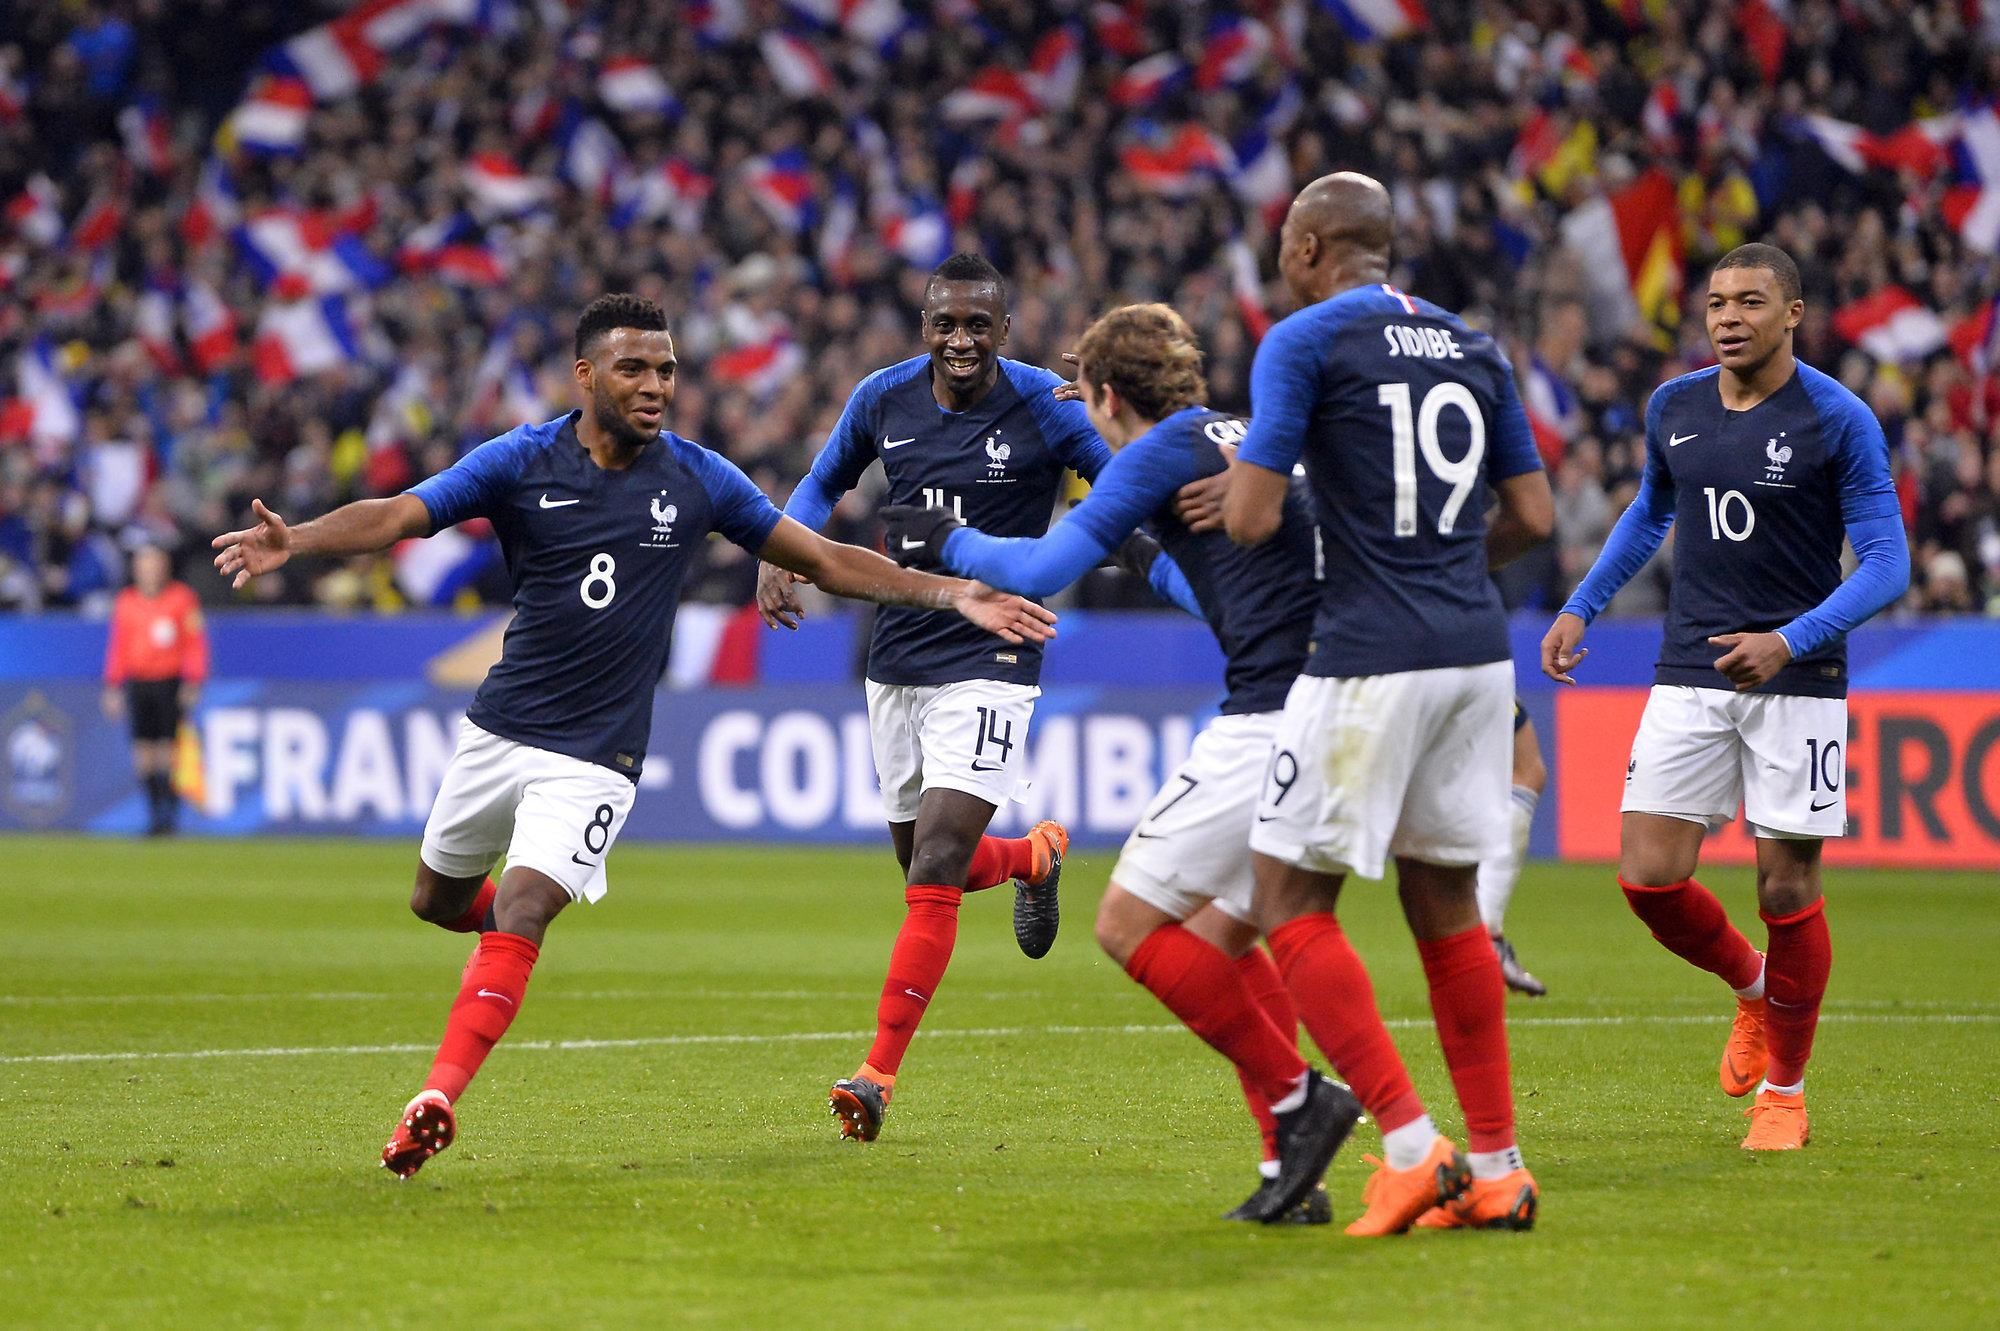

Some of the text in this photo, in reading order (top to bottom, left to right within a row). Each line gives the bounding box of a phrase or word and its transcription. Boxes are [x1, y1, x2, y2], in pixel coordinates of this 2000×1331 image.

[1384, 325, 1464, 359] SIDIBE
[1378, 382, 1485, 537] 19
[1703, 487, 1755, 542] 10
[580, 553, 616, 609] 8
[977, 706, 1013, 763] 14
[203, 708, 467, 823] FRAN
[698, 711, 1192, 830] COLMBI
[1266, 747, 1298, 806] 9
[1806, 738, 1841, 793] 10
[1150, 773, 1199, 821] 7
[584, 803, 614, 854] 8
